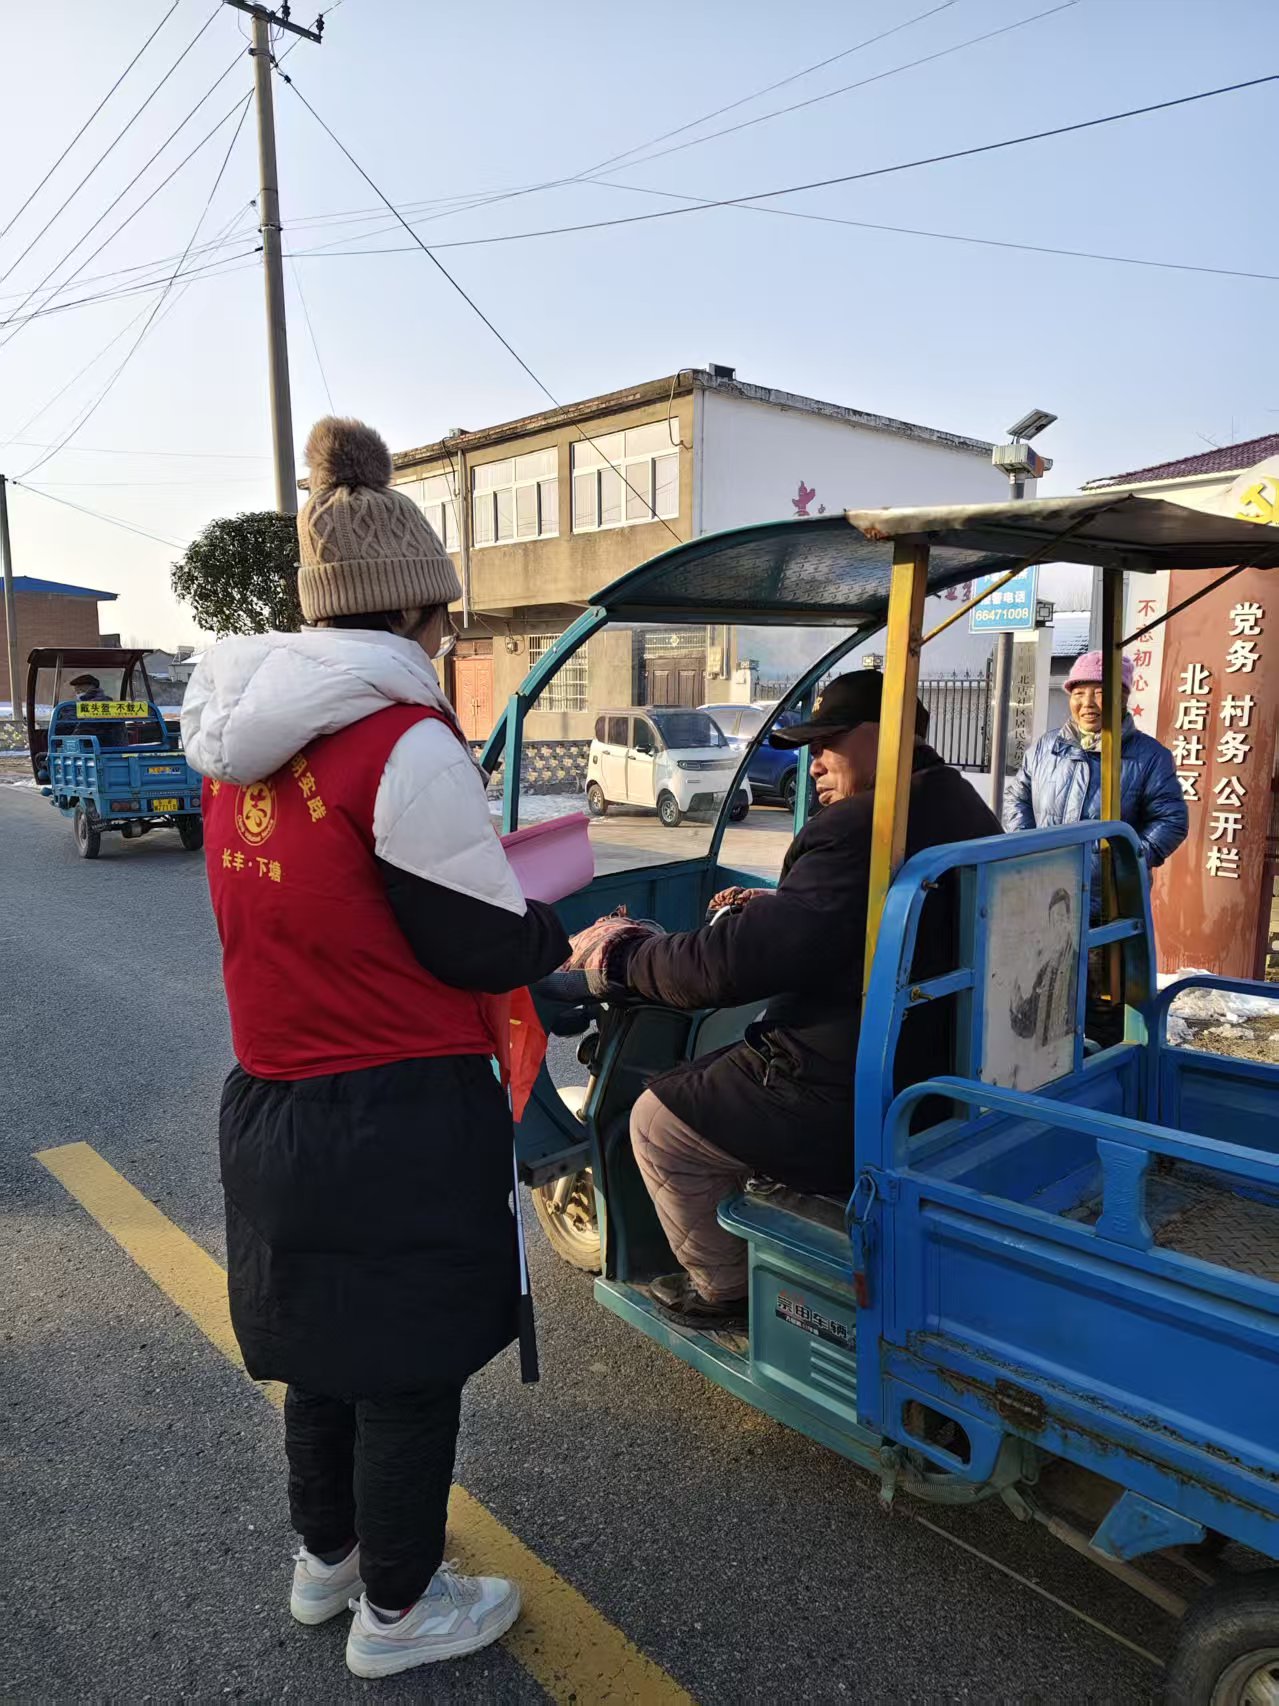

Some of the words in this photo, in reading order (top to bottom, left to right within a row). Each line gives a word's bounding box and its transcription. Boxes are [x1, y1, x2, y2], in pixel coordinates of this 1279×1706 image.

[975, 607, 1029, 621] 66471008
[1172, 663, 1211, 802] 北店社区
